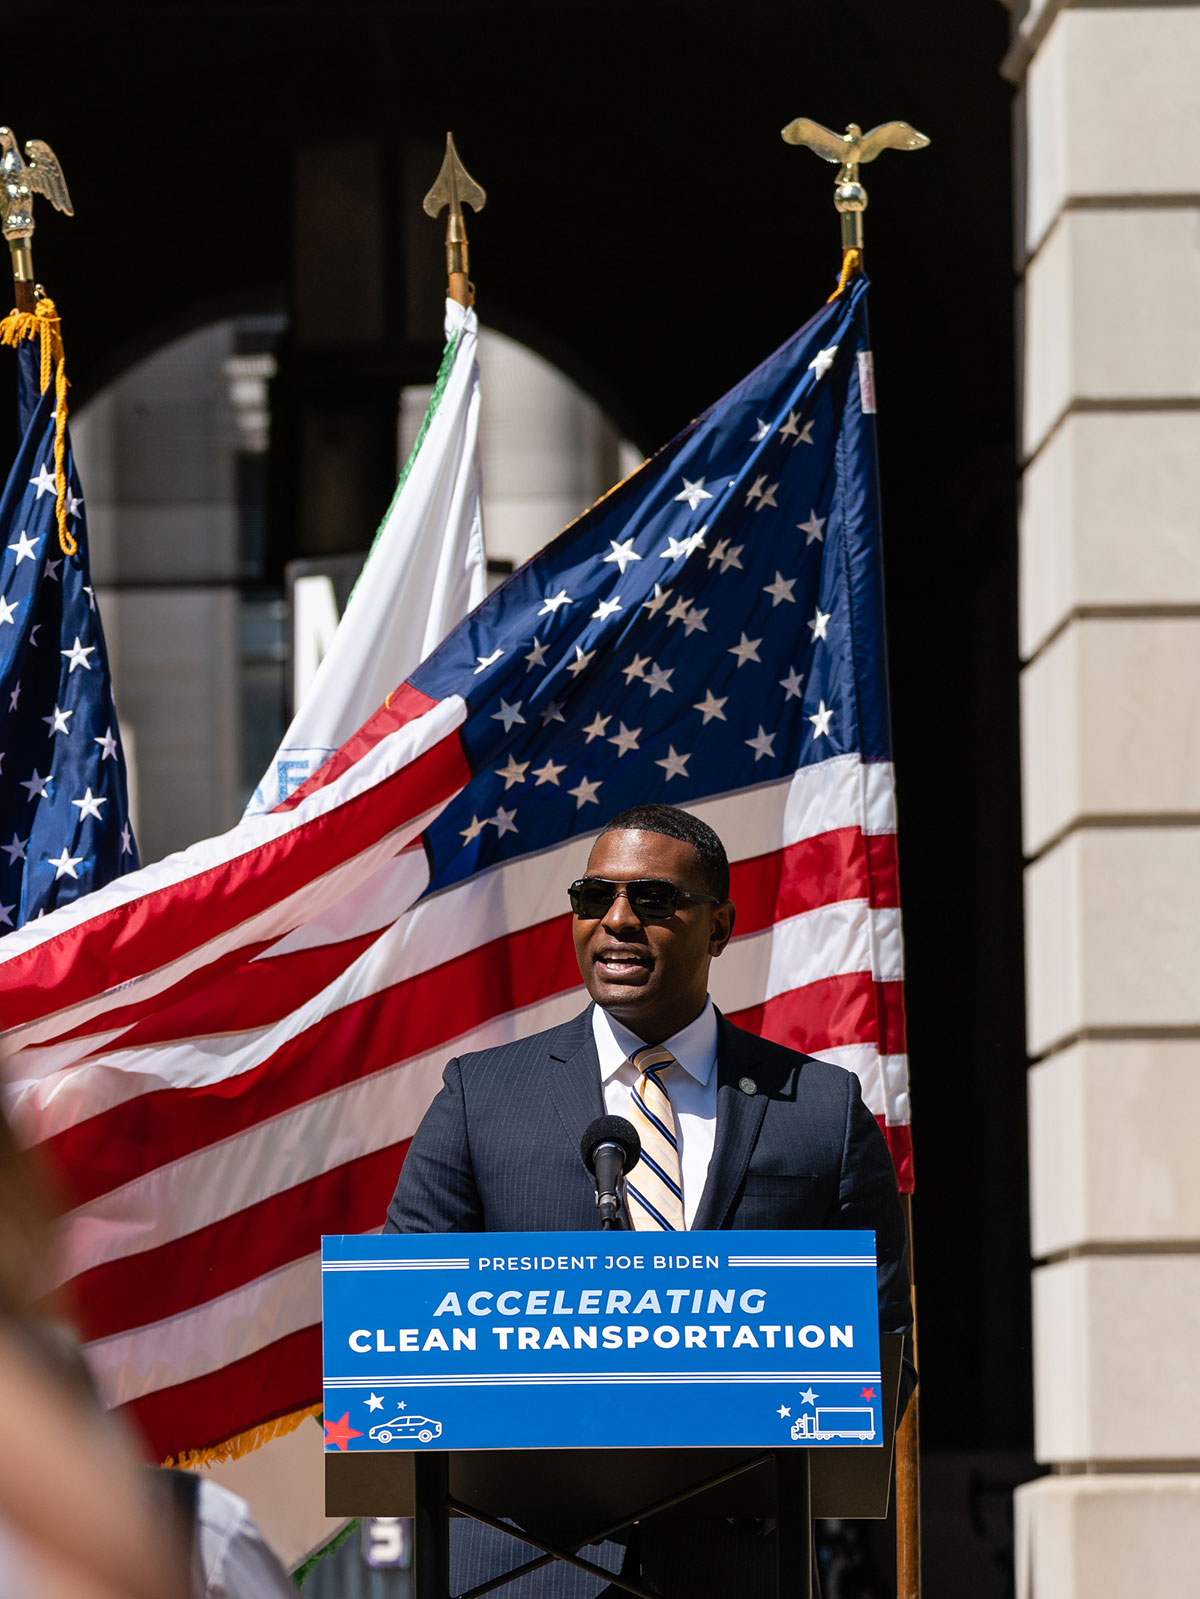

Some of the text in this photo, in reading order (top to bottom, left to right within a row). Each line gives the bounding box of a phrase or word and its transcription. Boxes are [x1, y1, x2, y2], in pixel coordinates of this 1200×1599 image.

[478, 1255, 720, 1271] PRESIDENT JOE BIDEN
[432, 1288, 767, 1317] ACCELERATING
[348, 1324, 854, 1353] CLEAN TRANSPORTATION
